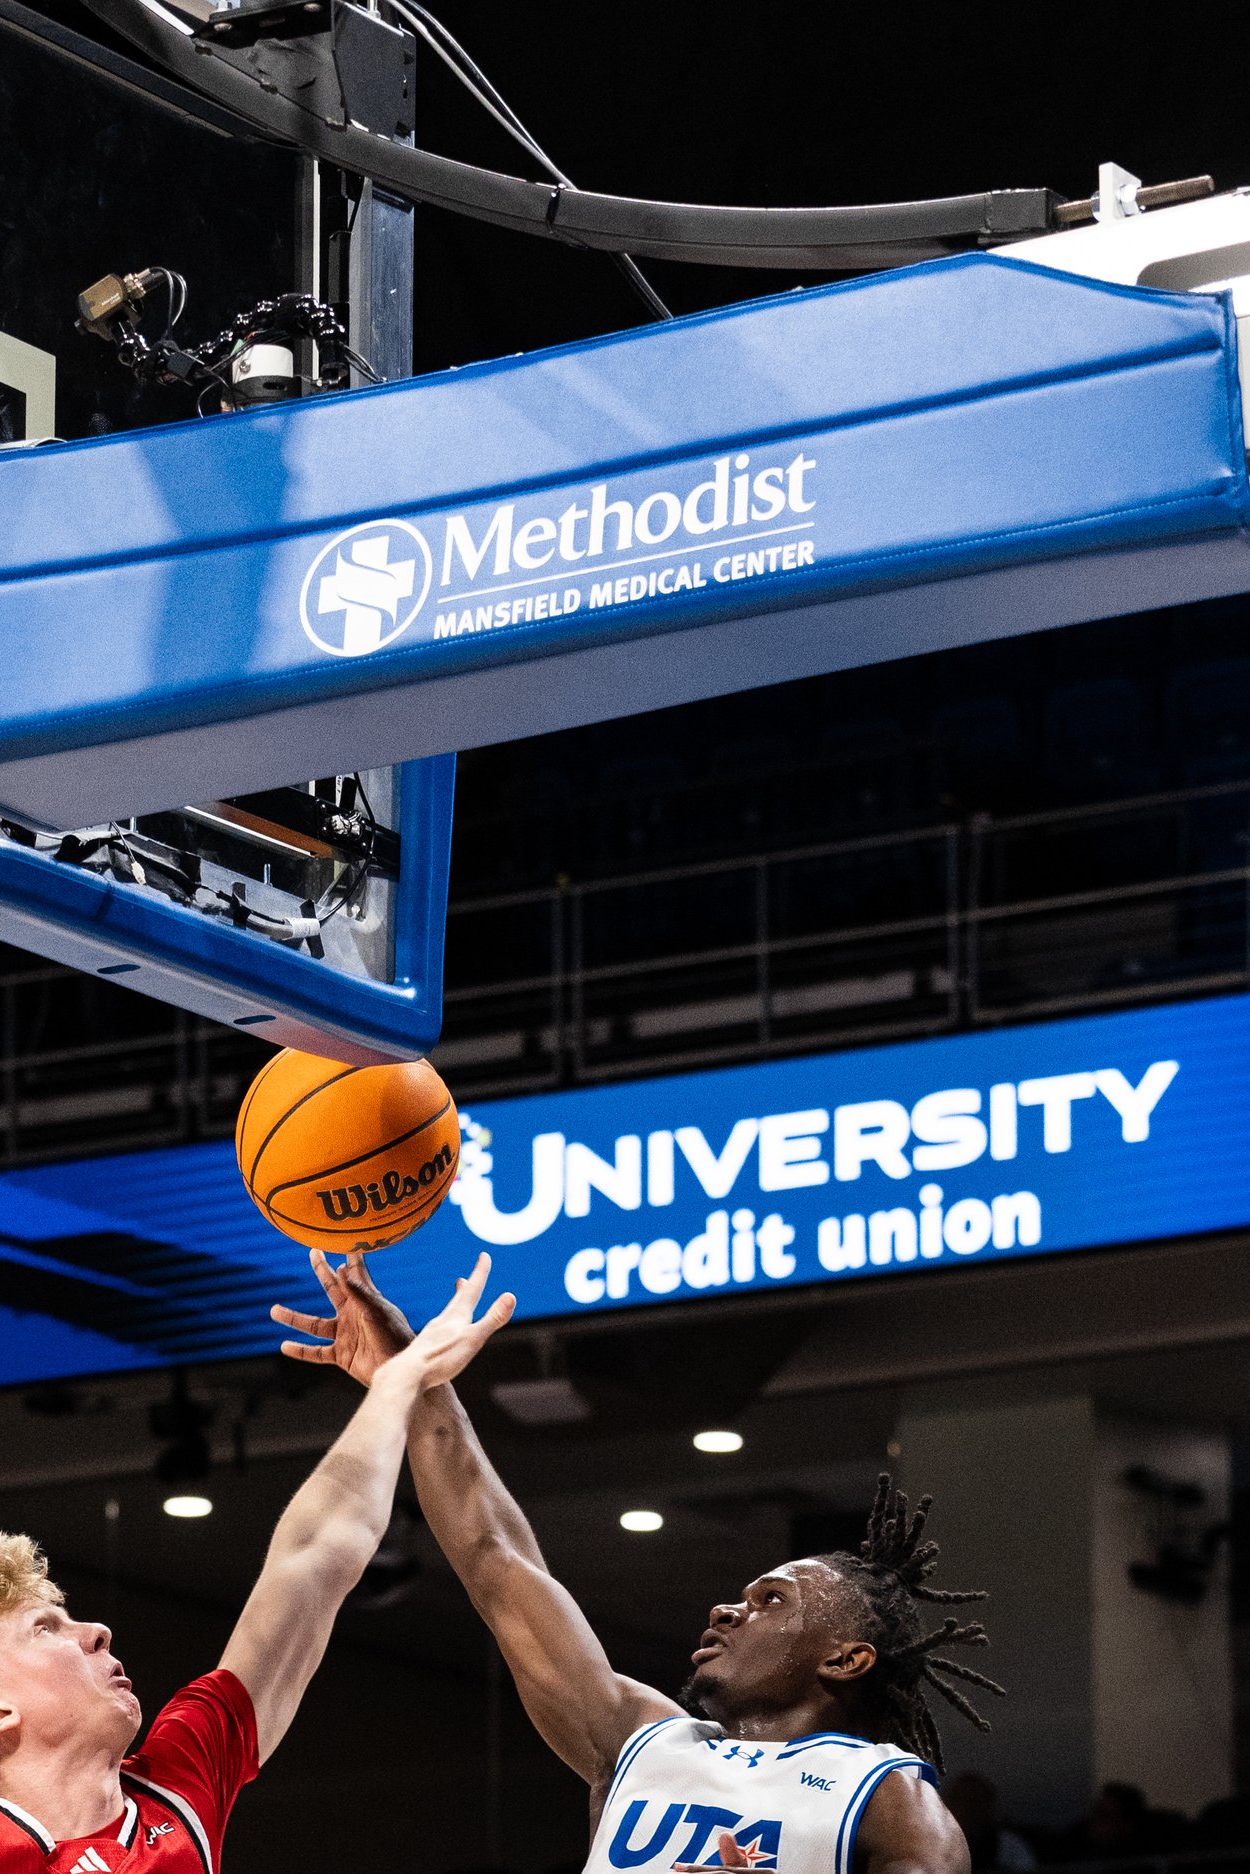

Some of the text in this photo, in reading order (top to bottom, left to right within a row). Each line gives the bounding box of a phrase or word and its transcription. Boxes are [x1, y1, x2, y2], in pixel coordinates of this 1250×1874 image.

[440, 452, 817, 587] Methodist
[433, 540, 815, 641] MANSFIELD MEDICAL CENTER
[316, 1142, 454, 1222] Wilson
[460, 1060, 1180, 1246] UNIVERSITY
[563, 1183, 1042, 1304] credit union
[799, 1771, 837, 1792] WAC
[607, 1799, 783, 1870] UTA
